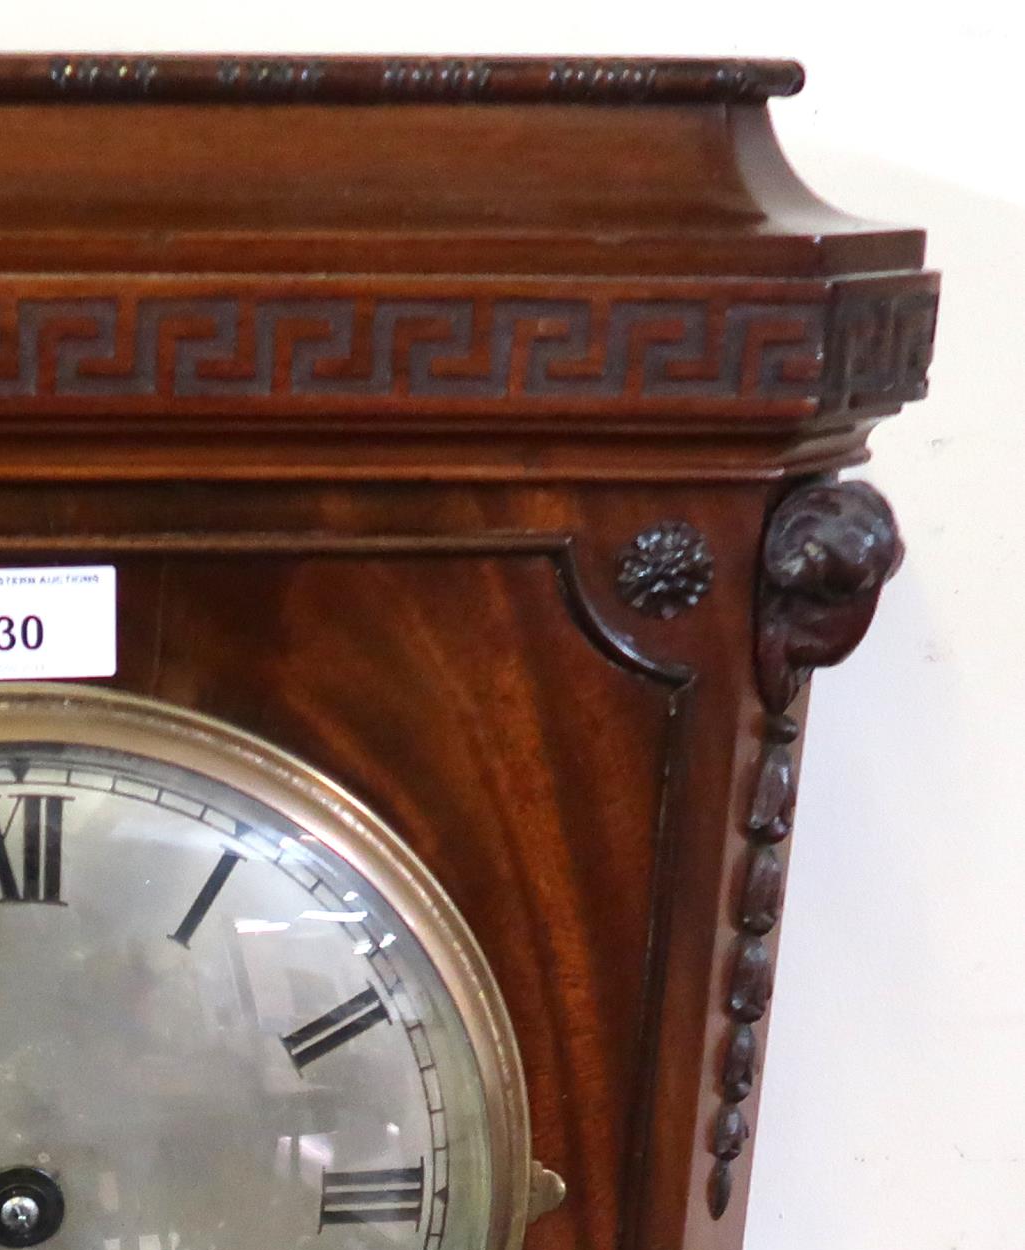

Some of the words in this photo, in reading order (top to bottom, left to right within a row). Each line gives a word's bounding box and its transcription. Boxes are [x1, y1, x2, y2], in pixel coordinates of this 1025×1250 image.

[167, 844, 247, 949] I
[279, 980, 393, 1079] II
[317, 1156, 425, 1234] III
